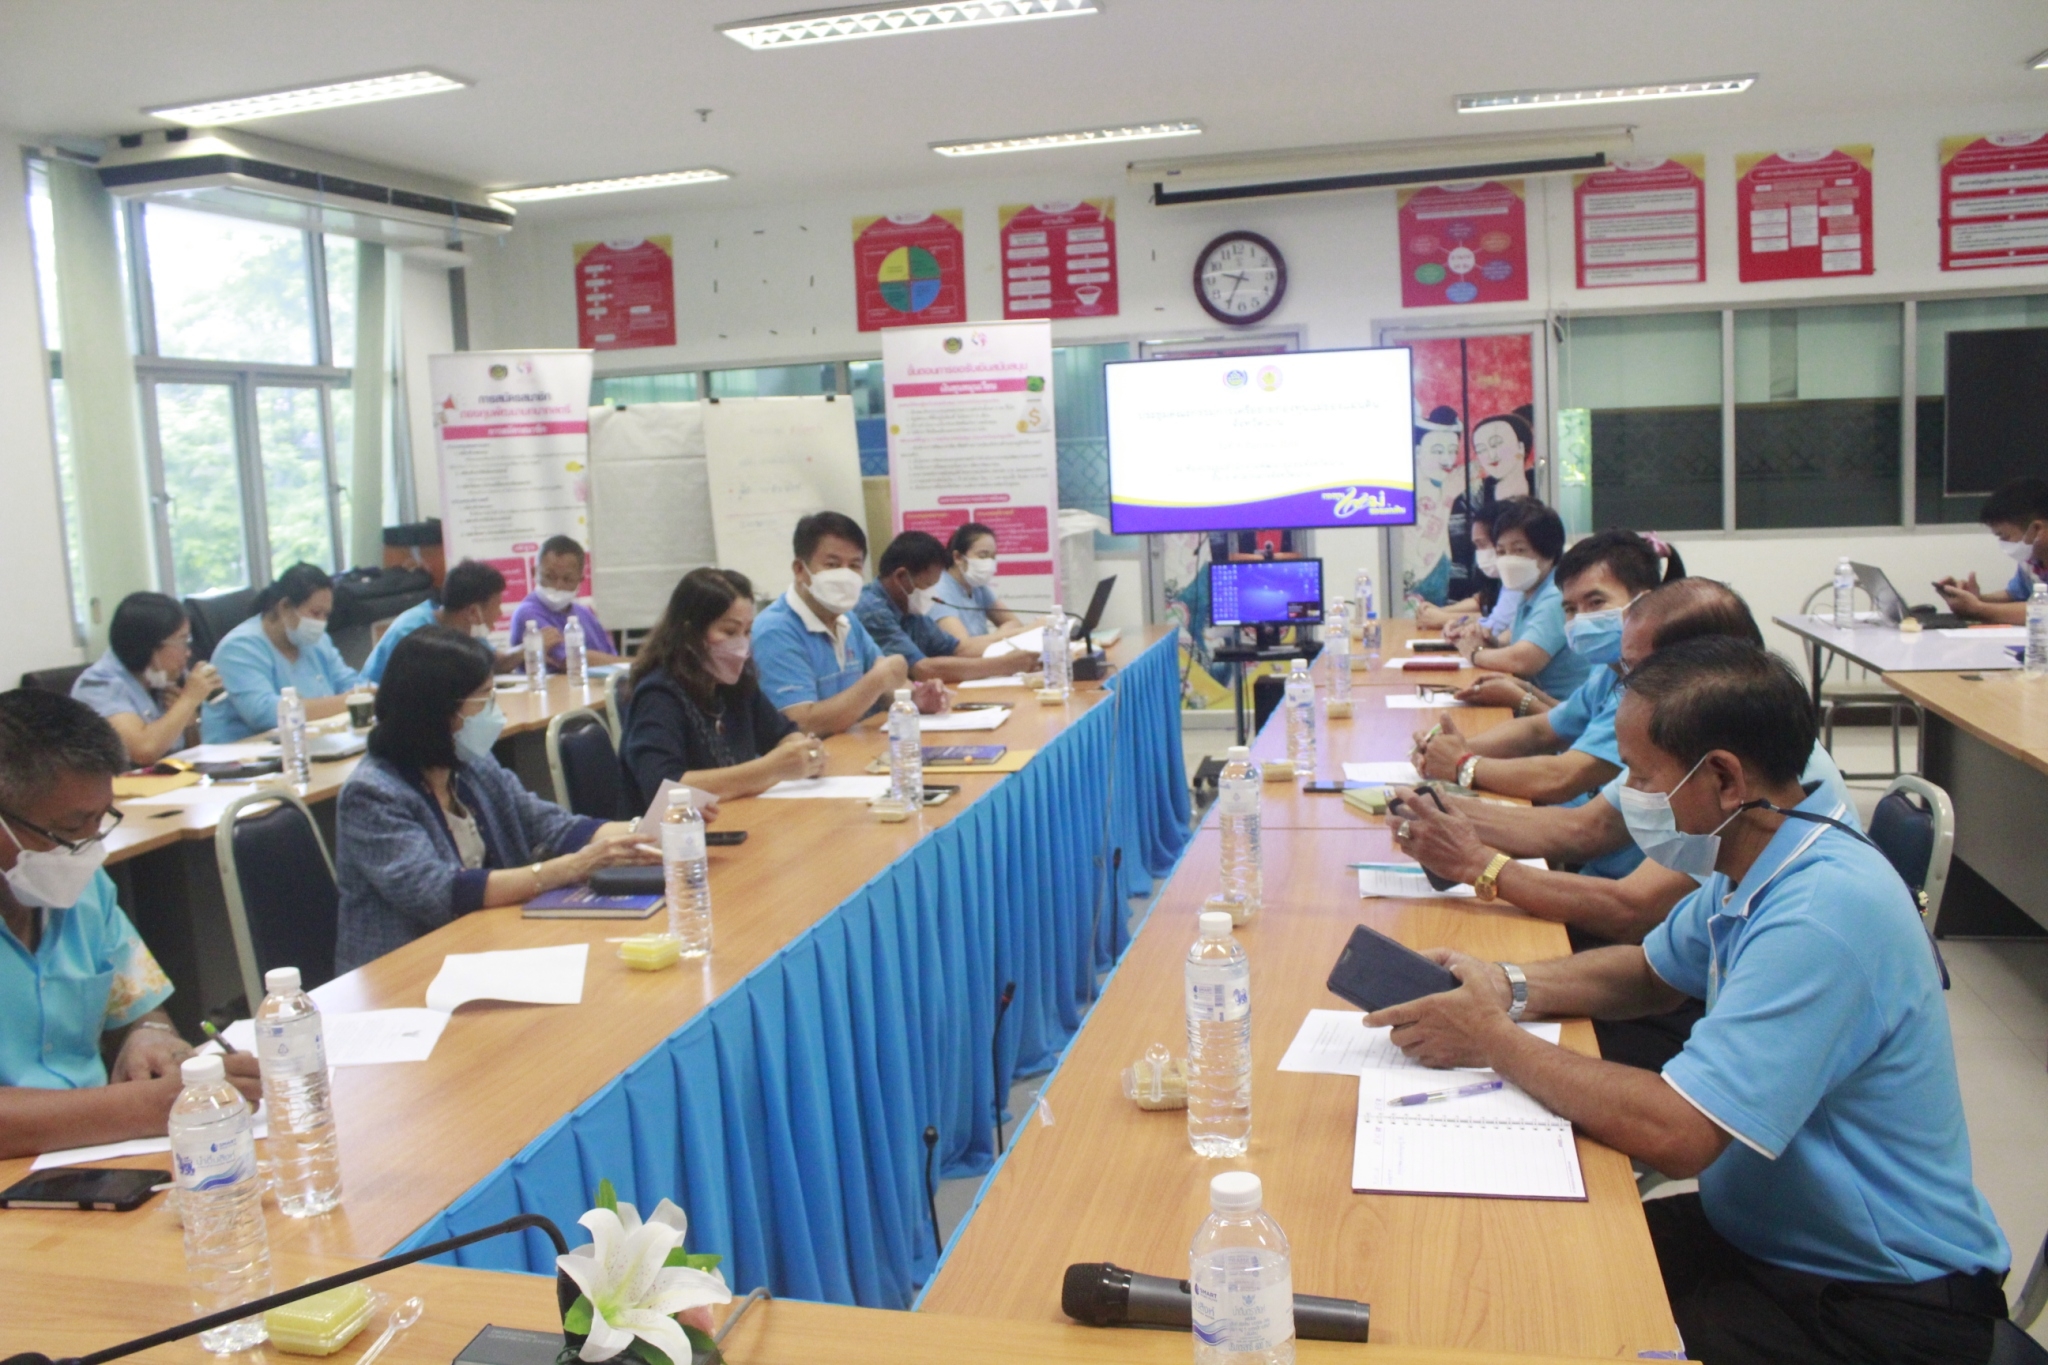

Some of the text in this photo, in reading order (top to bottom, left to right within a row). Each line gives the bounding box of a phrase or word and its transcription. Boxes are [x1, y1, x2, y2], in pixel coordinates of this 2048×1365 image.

[1232, 244, 1245, 255] 12
[1250, 247, 1255, 258] 1
[1221, 249, 1231, 260] 11
[1211, 262, 1222, 271] 10
[1261, 257, 1269, 267] 2
[1207, 277, 1216, 285] 9
[1265, 272, 1275, 281] 3
[1212, 290, 1221, 299] 8
[1263, 286, 1269, 295] 4
[1238, 302, 1247, 311] 6
[1251, 298, 1260, 307] 5
[1200, 1287, 1217, 1299] SMART
